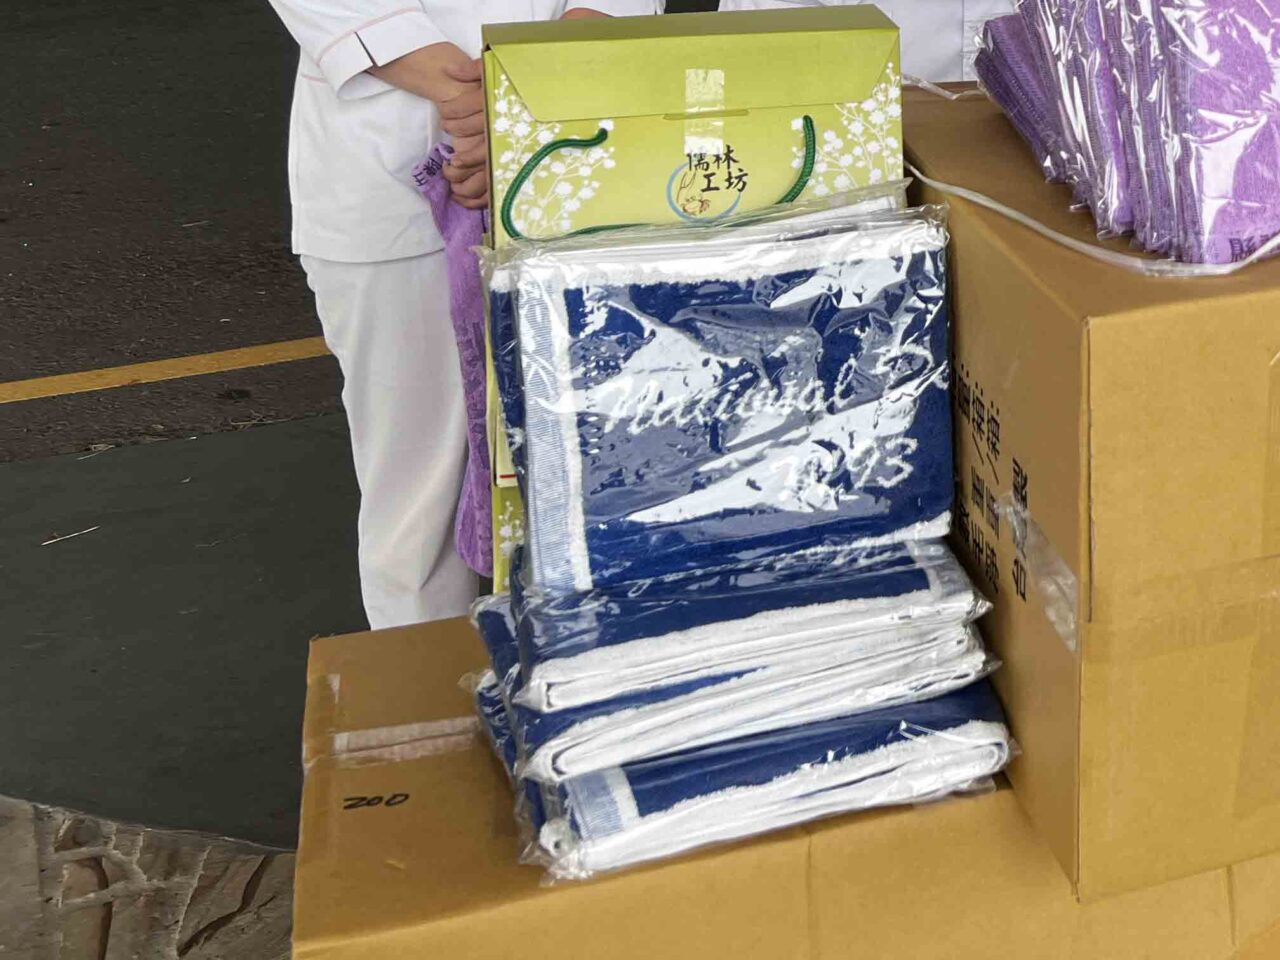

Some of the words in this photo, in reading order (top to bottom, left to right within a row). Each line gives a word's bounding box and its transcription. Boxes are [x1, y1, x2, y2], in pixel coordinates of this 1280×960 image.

[686, 143, 740, 172] 儒林
[700, 167, 749, 193] 工坊
[343, 792, 411, 811] 200
